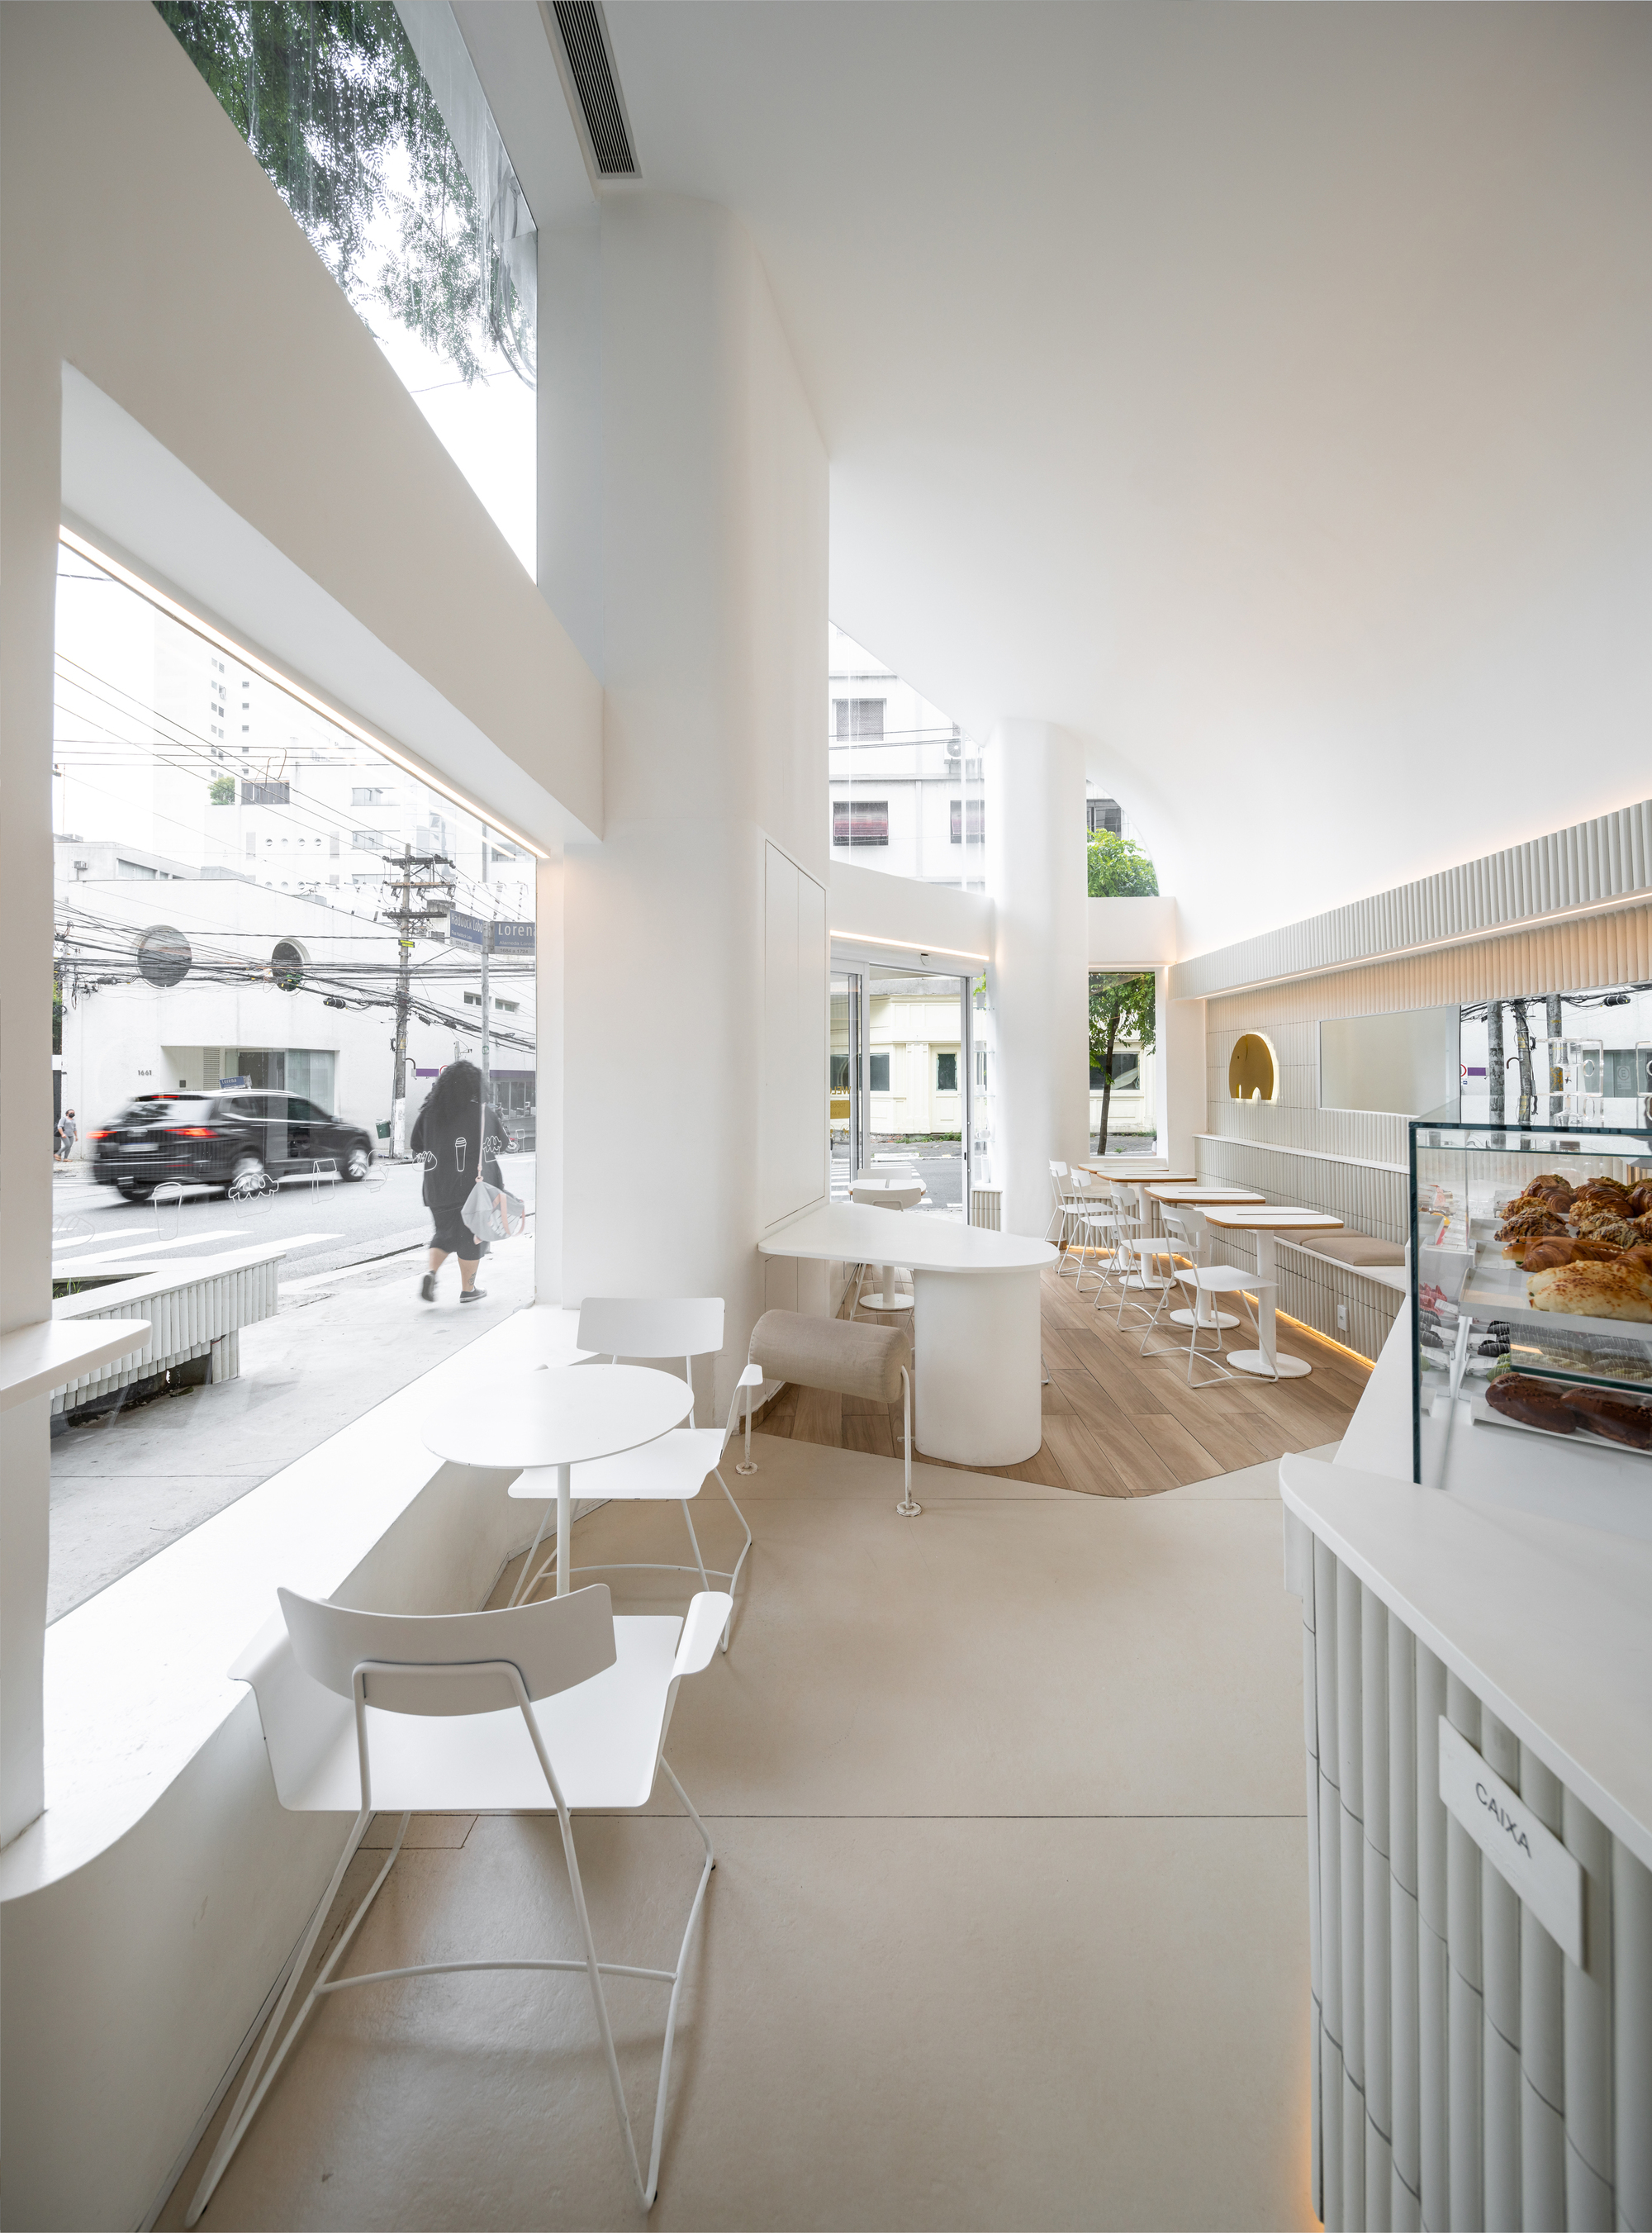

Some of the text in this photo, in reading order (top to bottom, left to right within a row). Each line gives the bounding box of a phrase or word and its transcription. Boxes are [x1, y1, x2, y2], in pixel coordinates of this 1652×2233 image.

[451, 913, 482, 933] Haddock Lobo
[1475, 1782, 1532, 1859] CAIXA
